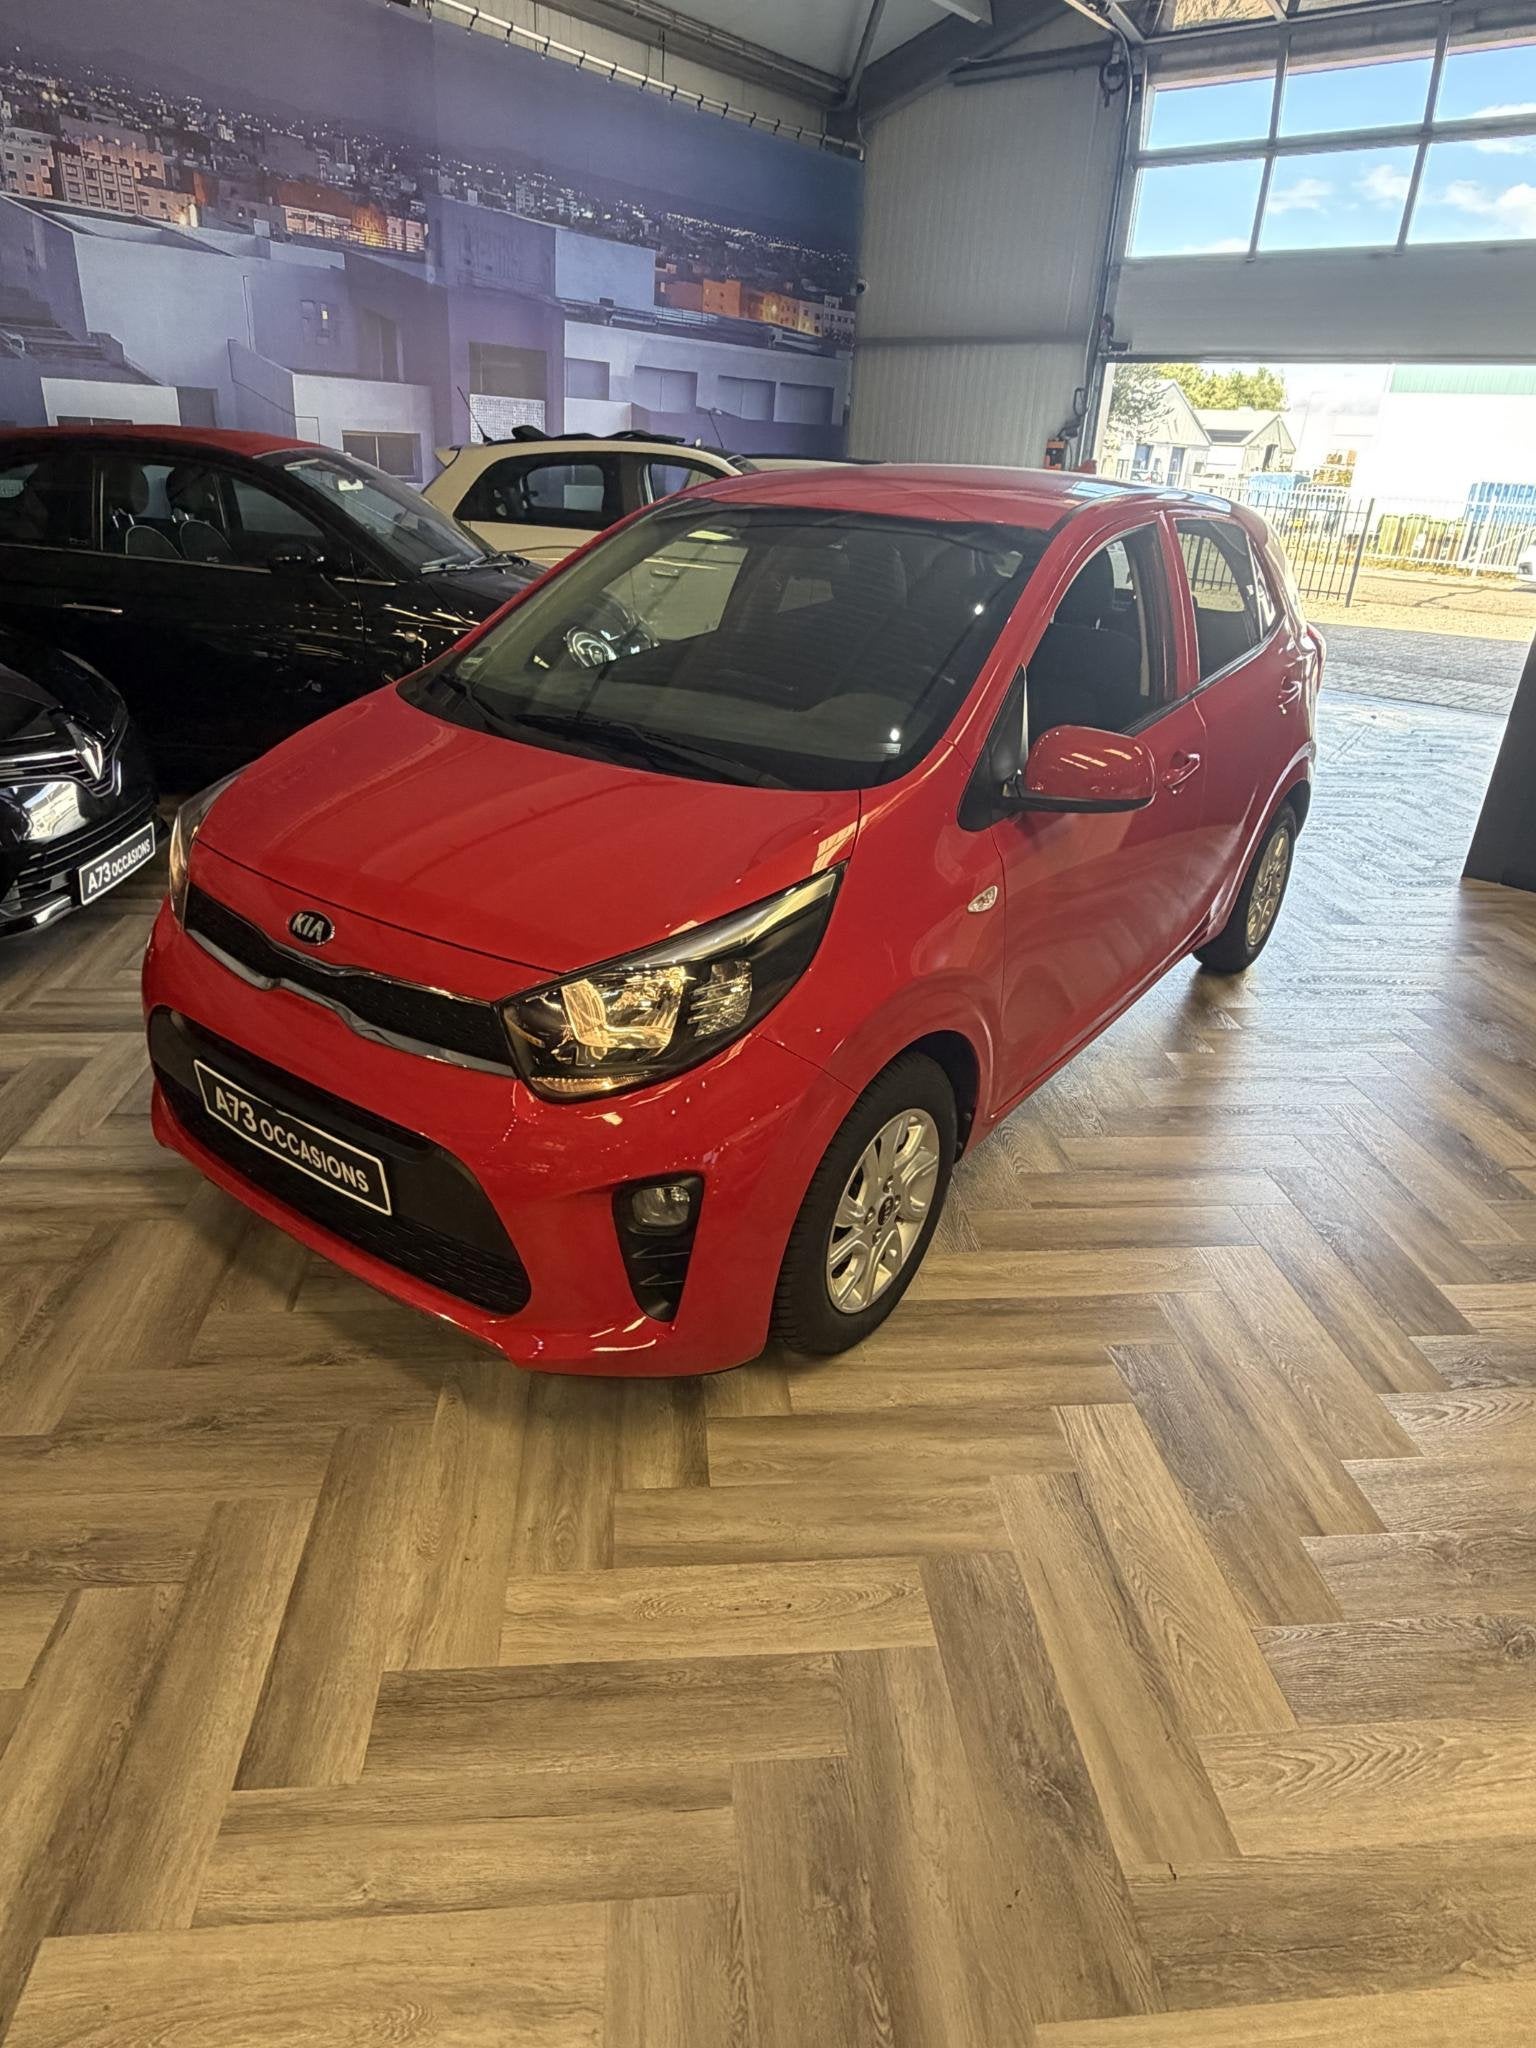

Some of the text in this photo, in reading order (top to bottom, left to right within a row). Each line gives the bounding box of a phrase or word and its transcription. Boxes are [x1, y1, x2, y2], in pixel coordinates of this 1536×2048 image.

[88, 838, 151, 894] A73 OCCASIONS
[292, 912, 325, 941] KIA
[215, 1086, 370, 1193] A73 OCCASIONS
